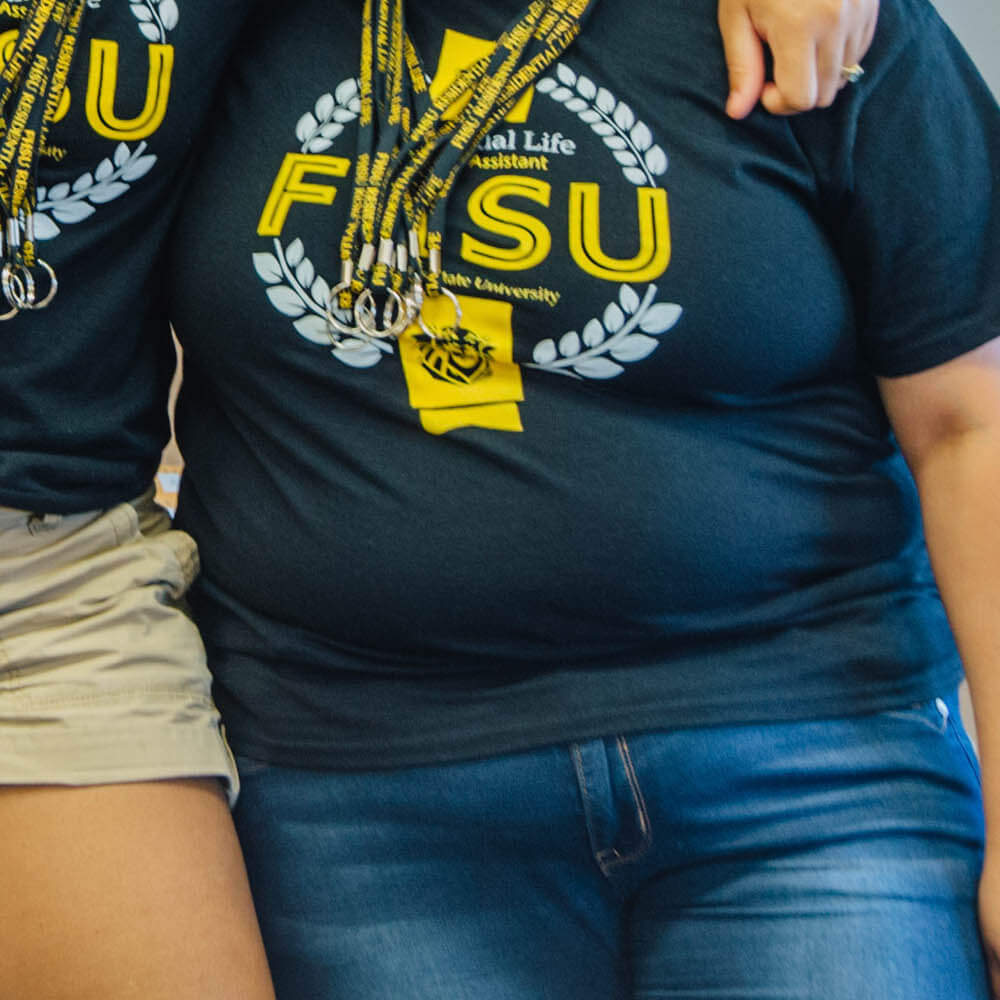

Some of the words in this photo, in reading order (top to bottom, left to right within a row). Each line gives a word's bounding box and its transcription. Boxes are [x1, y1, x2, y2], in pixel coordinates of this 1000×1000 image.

[531, 9, 559, 42] FHSU
[1, 50, 26, 82] LIFE
[24, 54, 48, 90] FHSU
[42, 33, 76, 124] RESIDENTIAL
[17, 128, 36, 166] FHSU
[449, 115, 479, 151] FHSU
[523, 129, 577, 156] Life
[470, 151, 549, 171] Assistant
[257, 151, 673, 283] FSU
[474, 276, 561, 307] University
